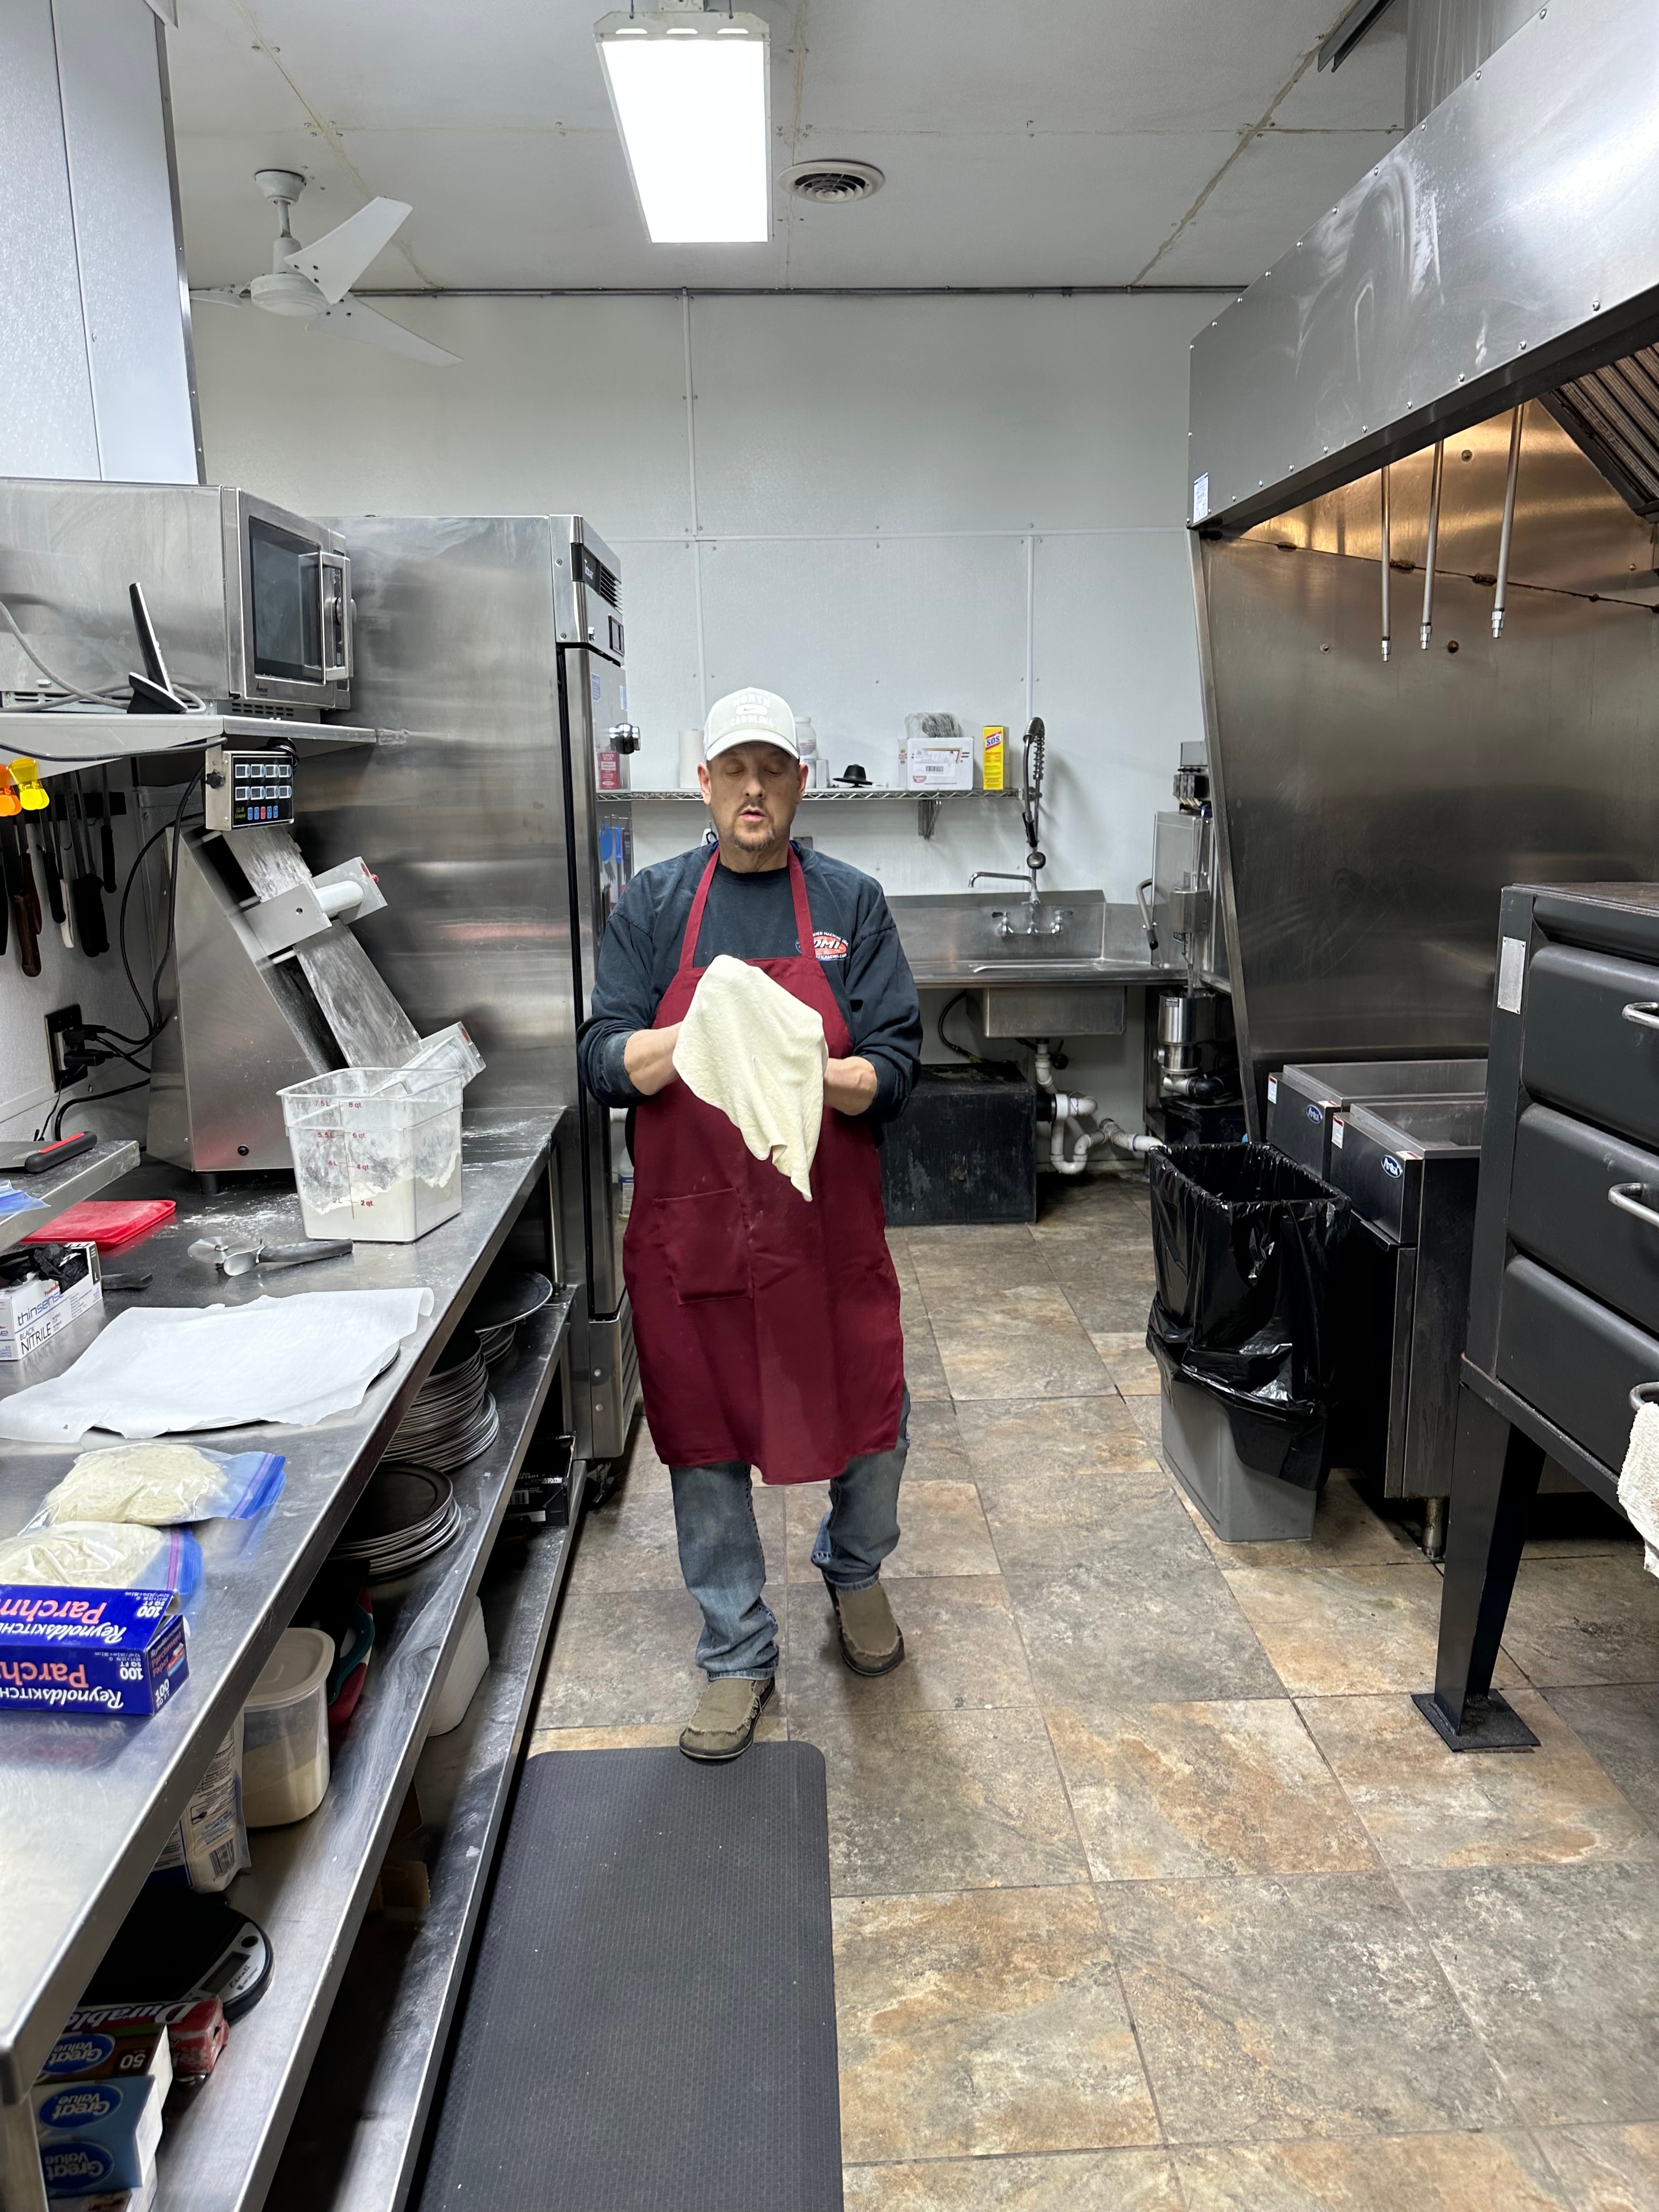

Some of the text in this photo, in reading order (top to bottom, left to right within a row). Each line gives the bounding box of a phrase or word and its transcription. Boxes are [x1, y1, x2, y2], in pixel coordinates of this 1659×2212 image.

[733, 694, 770, 707] NORTH
[730, 714, 774, 727] CAROLINA
[20, 1326, 35, 1341] BLACK
[21, 1323, 52, 1355] NITRILE
[137, 1605, 163, 1618] 100
[151, 1631, 183, 1668] Parchment
[0, 1661, 89, 1688] Parch
[119, 1668, 144, 1680] 100
[153, 1656, 169, 1677] Paper
[155, 1679, 170, 1702] 100
[48, 2048, 103, 2065] Great
[120, 2054, 146, 2069] 50
[58, 2093, 100, 2105] Value
[52, 2100, 110, 2120] Great
[44, 2152, 89, 2165] Value
[47, 2161, 104, 2180] Great
